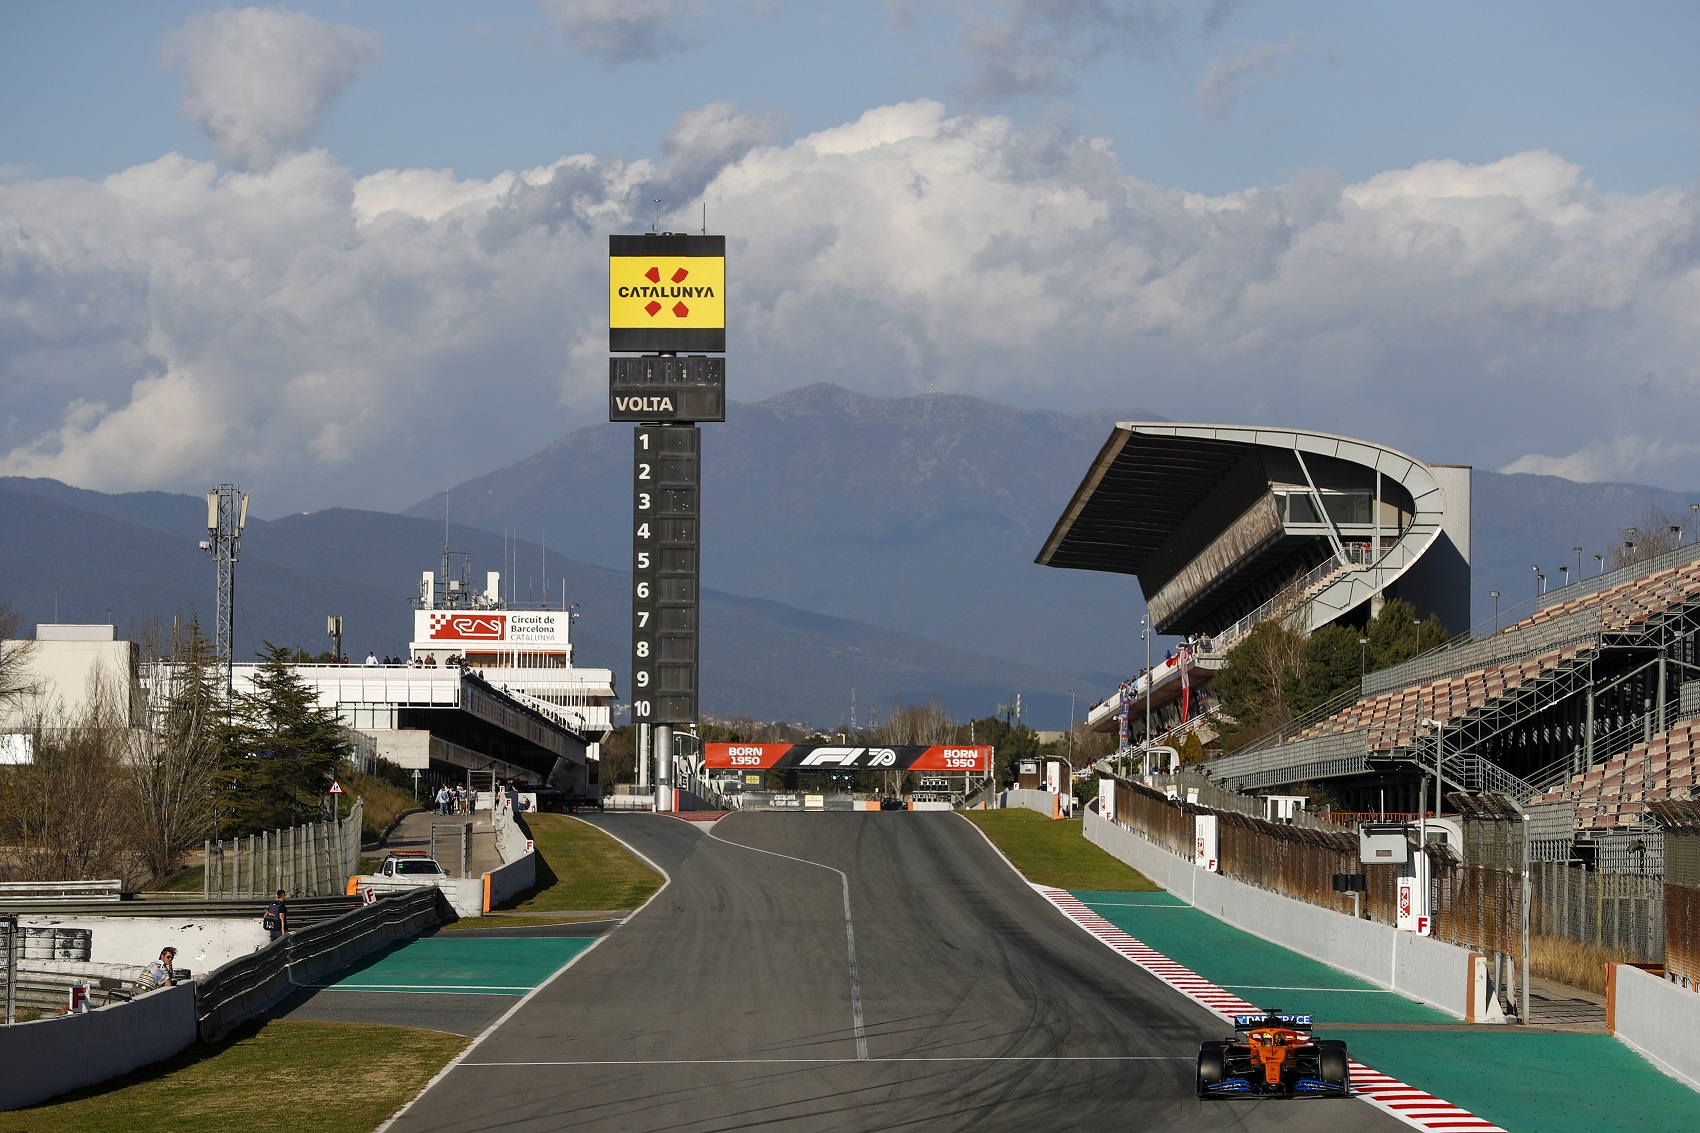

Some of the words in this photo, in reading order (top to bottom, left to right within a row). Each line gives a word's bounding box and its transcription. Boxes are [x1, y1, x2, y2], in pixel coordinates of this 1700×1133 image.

[618, 286, 715, 298] CATALUNYA
[615, 396, 674, 412] VOLTA
[638, 433, 649, 450] 1
[638, 463, 651, 480] 2
[638, 493, 651, 509] 3
[637, 523, 651, 539] 4
[637, 552, 650, 569] 5
[636, 582, 650, 598] 6
[511, 616, 542, 624] Circuit
[543, 616, 555, 624] de
[637, 611, 650, 628] 7
[511, 625, 555, 633] Barcelona
[636, 641, 650, 657] 8
[636, 670, 650, 687] 9
[634, 700, 651, 717] 10
[728, 747, 763, 756] BORN
[800, 747, 867, 766] F1
[943, 749, 978, 758] BORN
[730, 756, 761, 765] 1950
[945, 758, 976, 768] 1950
[506, 799, 511, 807] F
[1106, 812, 1112, 820] F
[527, 841, 533, 850] F
[1208, 859, 1216, 870] F
[366, 888, 374, 903] F
[1417, 917, 1428, 933] F
[72, 987, 87, 1009] F
